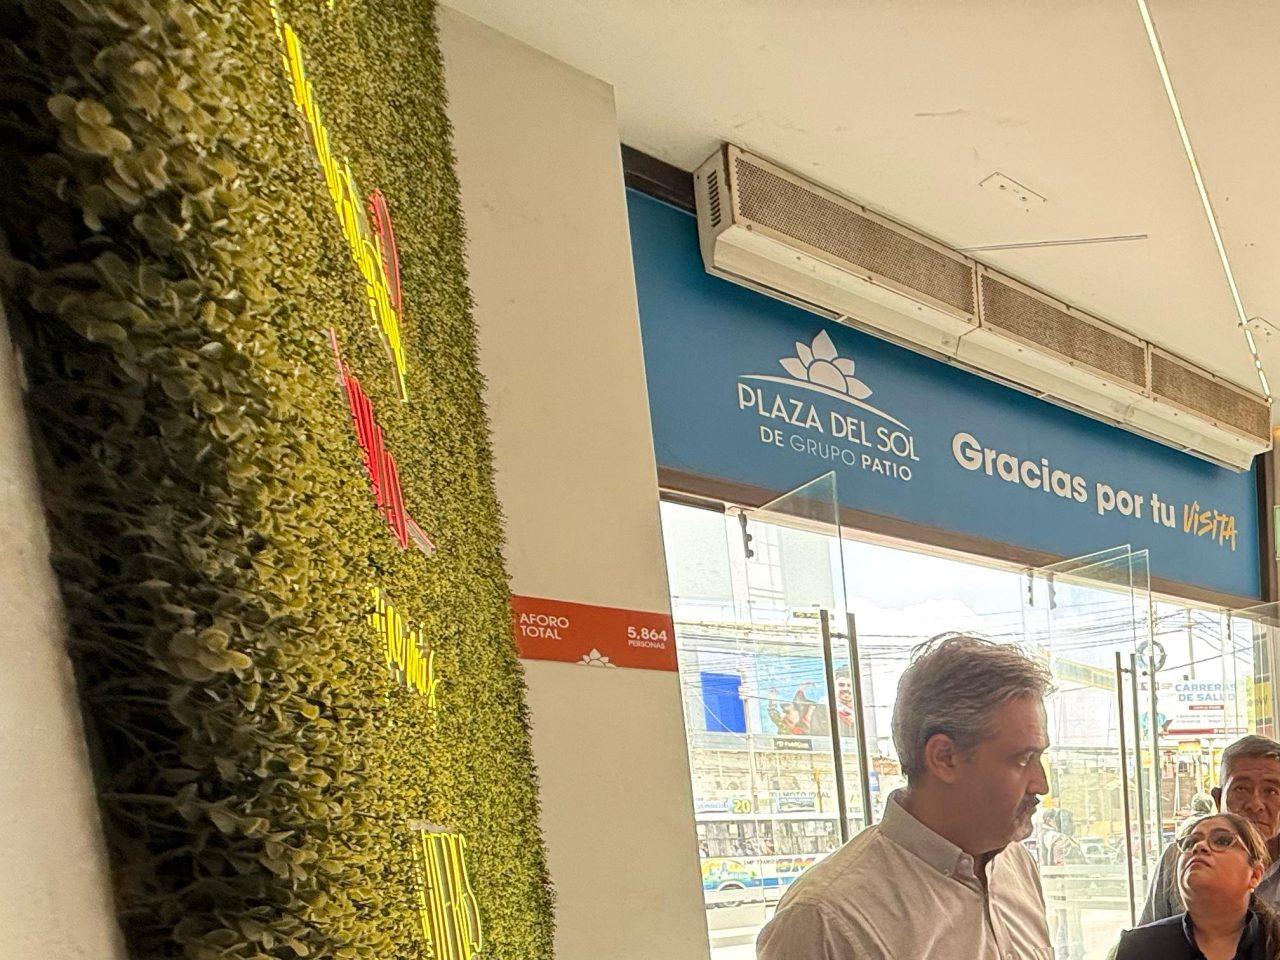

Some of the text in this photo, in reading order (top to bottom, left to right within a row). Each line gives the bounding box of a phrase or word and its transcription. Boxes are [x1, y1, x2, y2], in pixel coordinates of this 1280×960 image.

[737, 383, 920, 461] PLAZA DEL SOL
[760, 425, 912, 482] DE GRUPO PATIO
[952, 431, 1087, 504] Gracias
[1096, 482, 1143, 521] por
[1150, 493, 1175, 529] tu
[519, 613, 668, 642] AFORO 5.864
[520, 625, 666, 649] TOTAL PERSONAS
[1175, 682, 1236, 692] CARRERAS
[1178, 693, 1236, 702] DE SALUD
[732, 799, 751, 814] 20
[808, 791, 831, 799] IDAL
